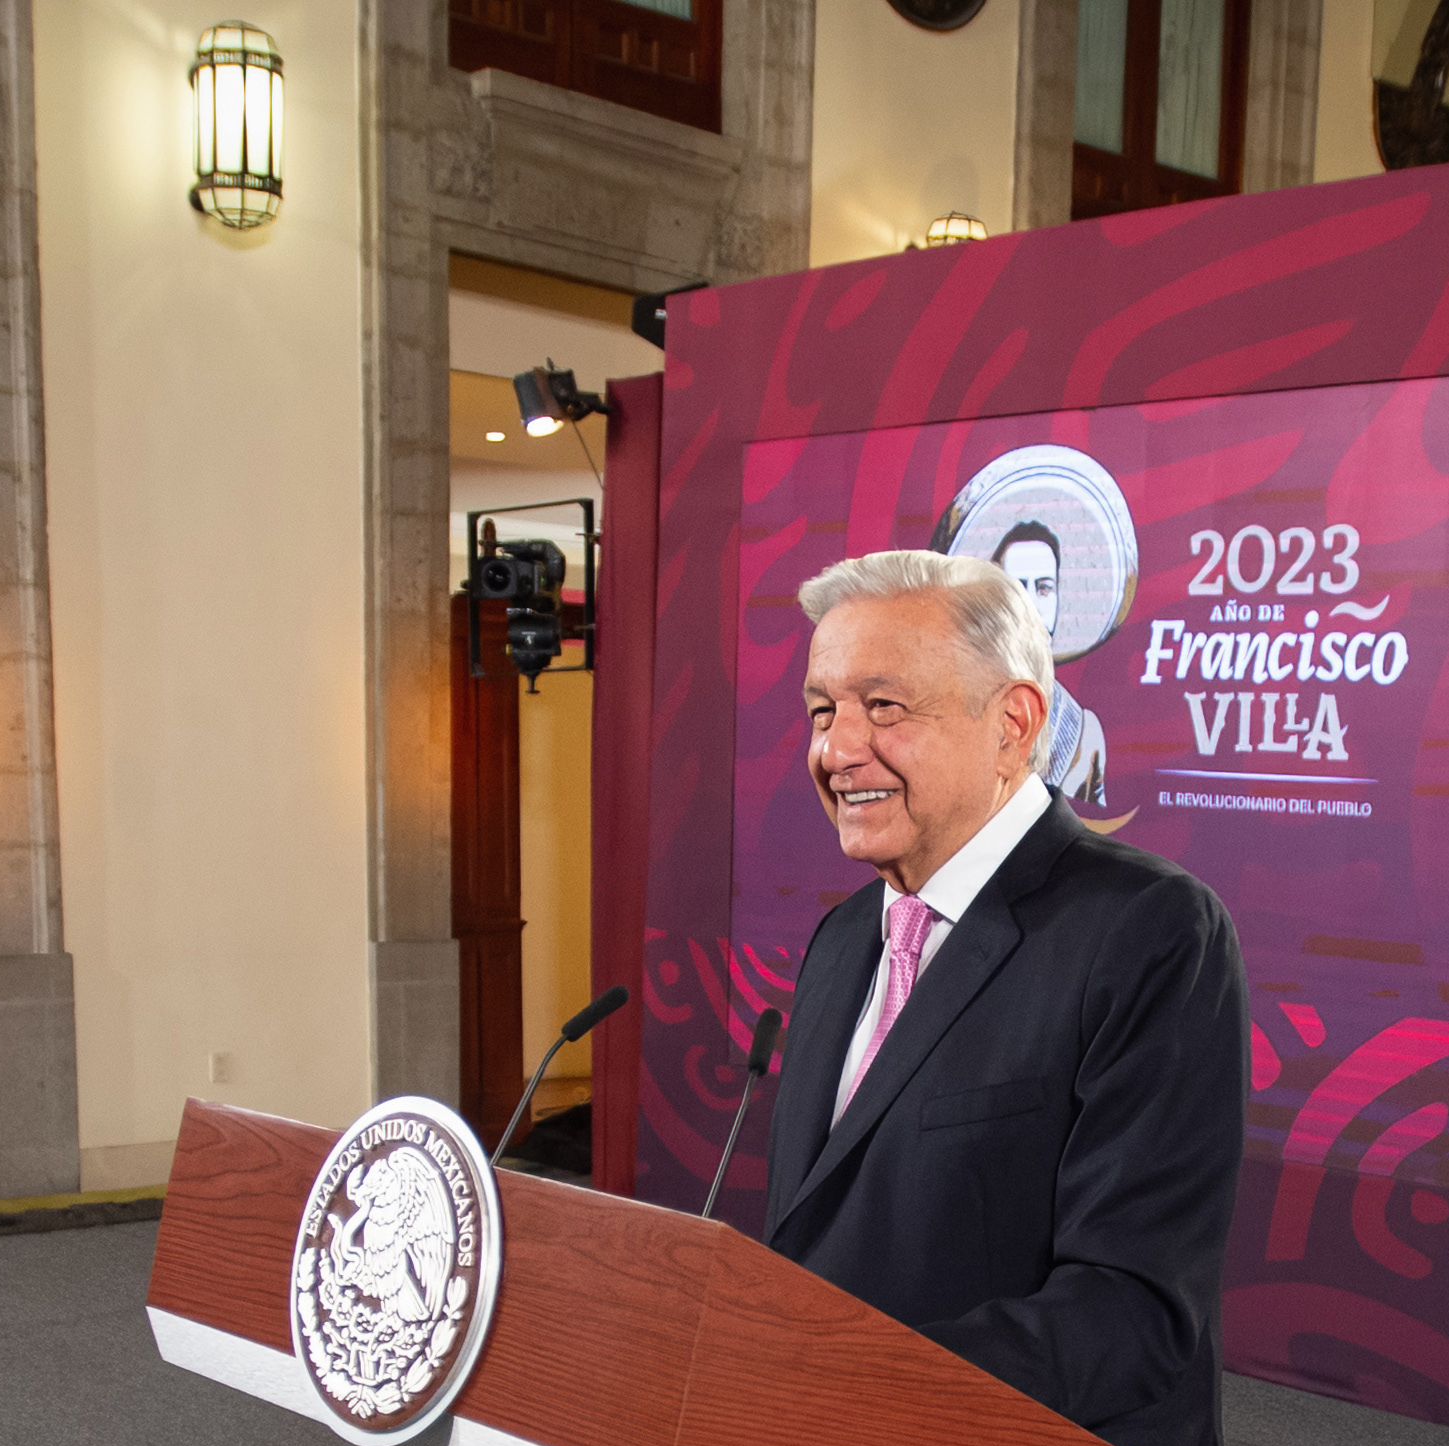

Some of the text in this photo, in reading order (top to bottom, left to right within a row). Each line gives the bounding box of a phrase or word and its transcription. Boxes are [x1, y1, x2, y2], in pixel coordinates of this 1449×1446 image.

[1188, 523, 1361, 597] 2023
[1210, 599, 1285, 622] AÑO DE
[1140, 610, 1409, 685] Francisco
[1183, 691, 1349, 761] VILLA
[1158, 791, 1373, 818] EL REVOLUCIONARIO DEL PUEBLO
[305, 1118, 475, 1267] ESTADOS UNIDOS MEXICANOS
